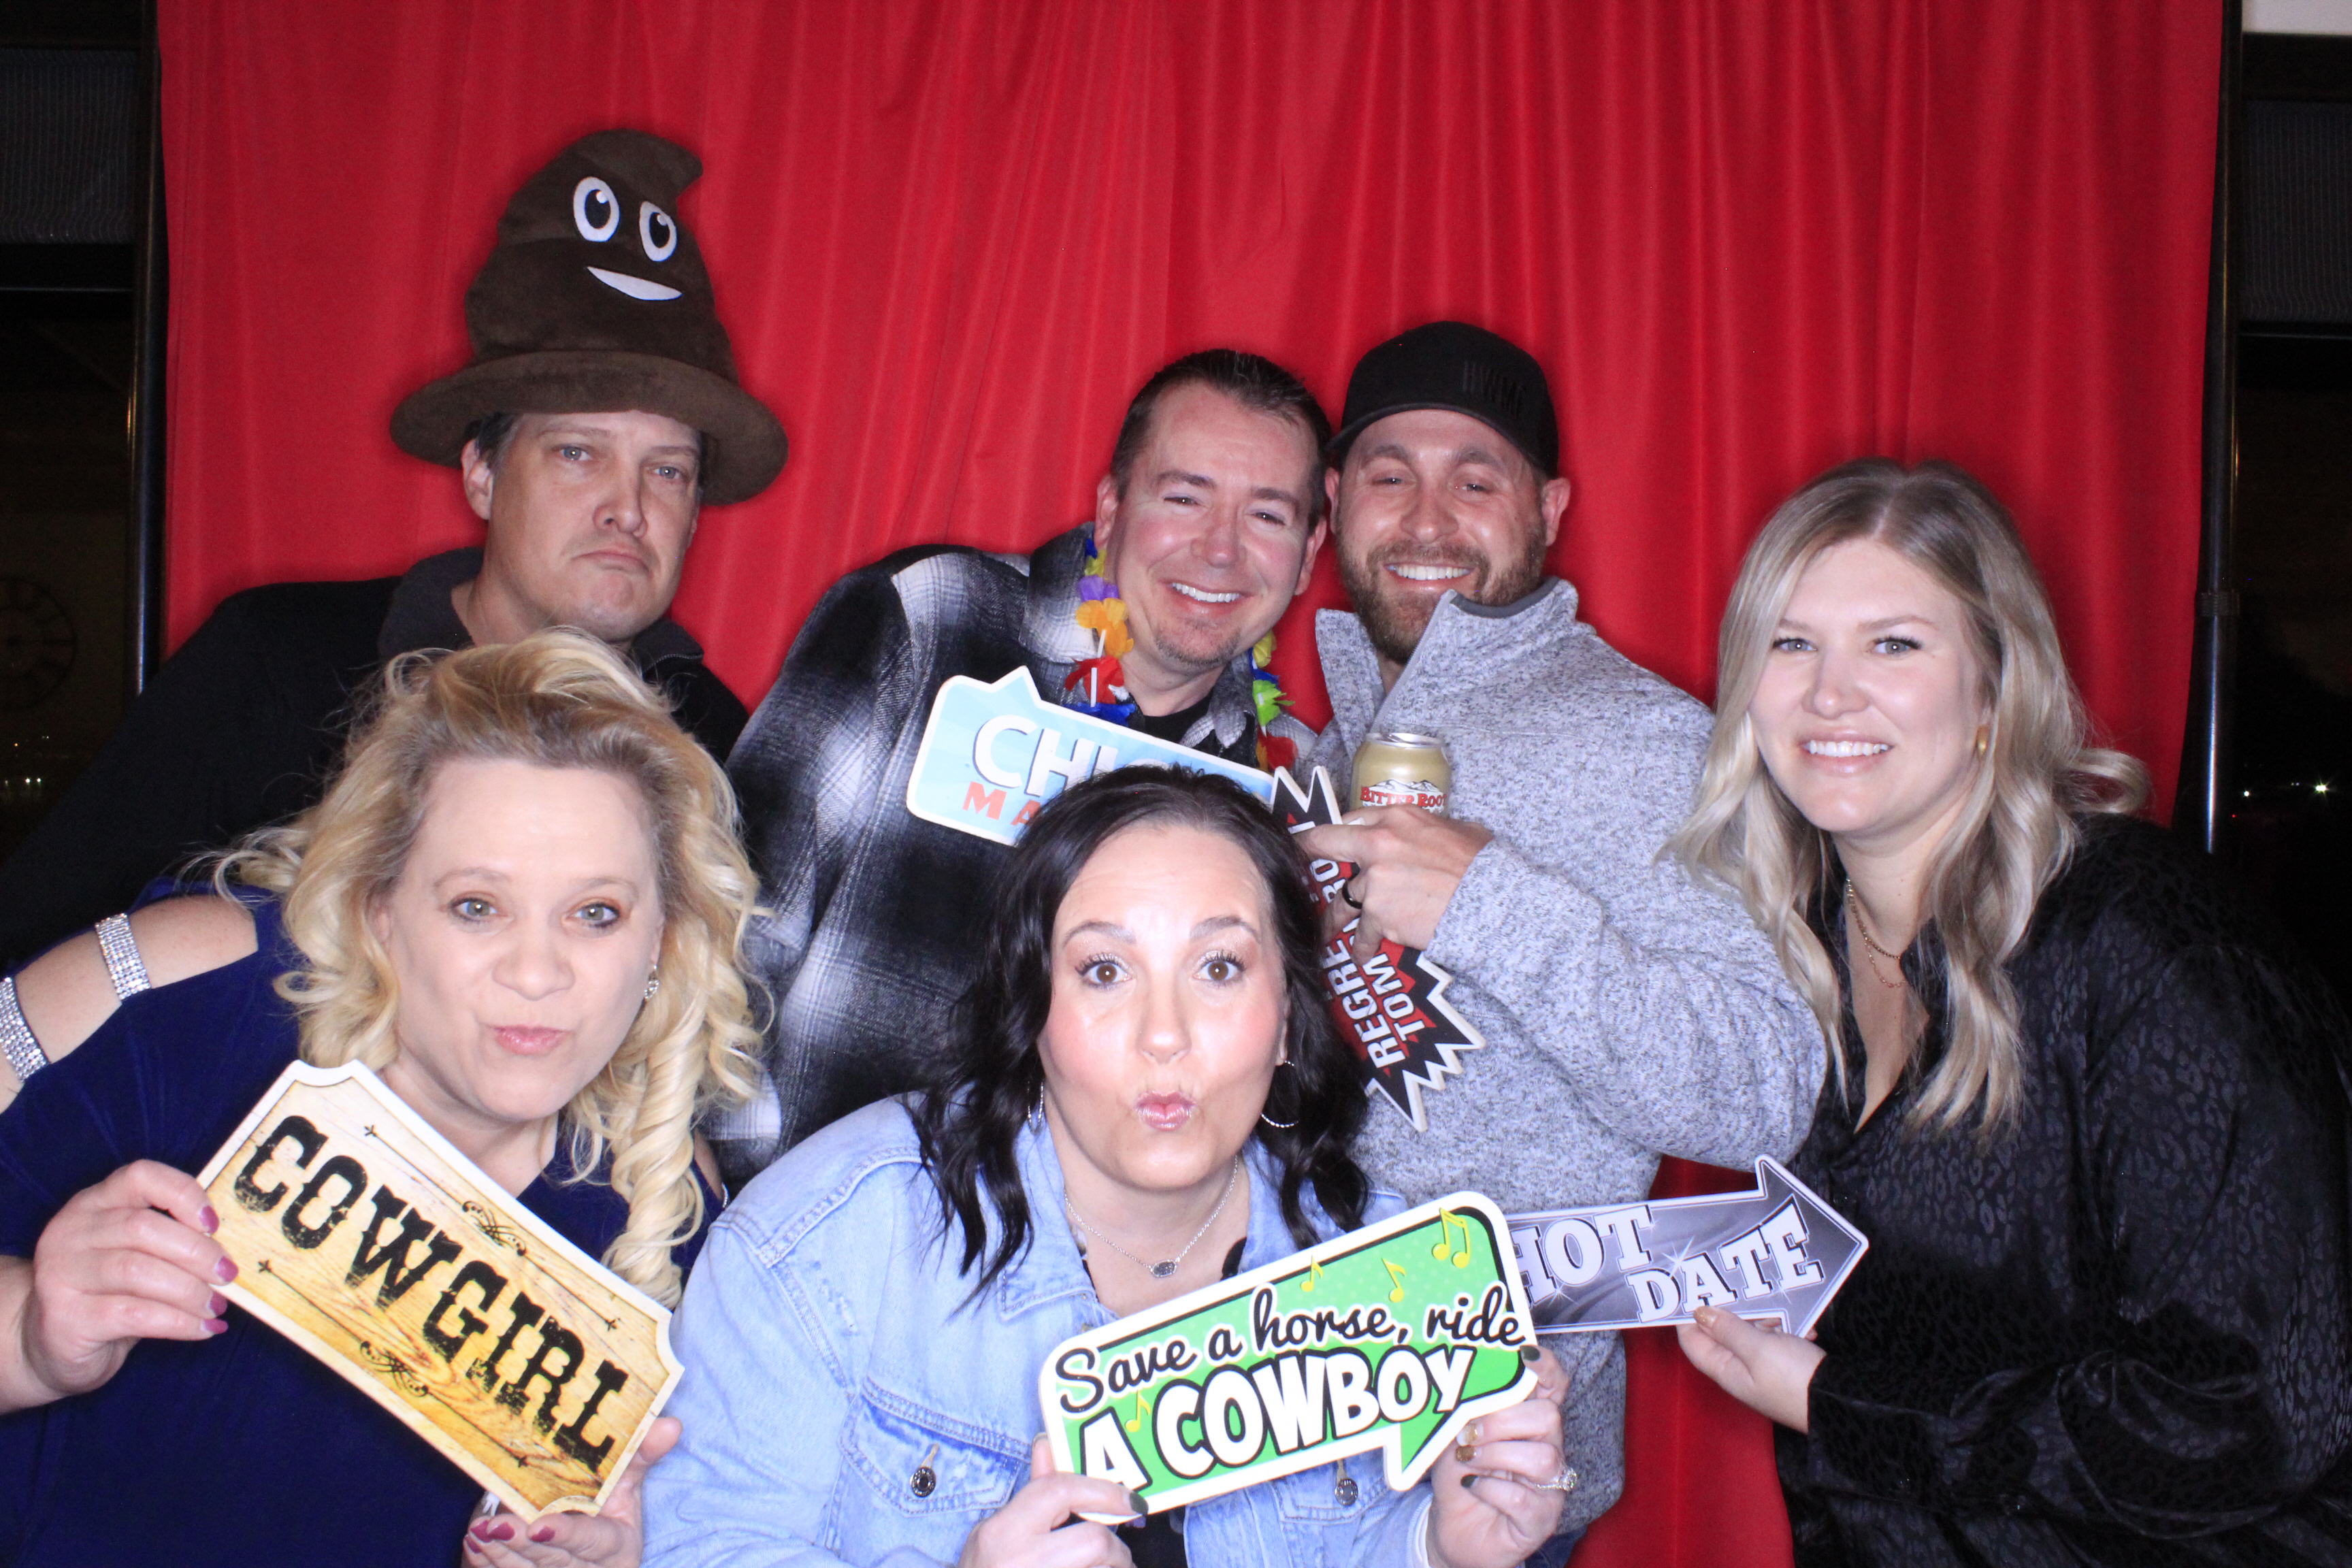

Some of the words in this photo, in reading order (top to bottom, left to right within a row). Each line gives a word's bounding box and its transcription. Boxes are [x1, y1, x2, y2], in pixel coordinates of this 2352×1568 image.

[1360, 787, 1414, 804] BITTER
[1319, 939, 1405, 1068] REGRE
[233, 1115, 629, 1475] COWGIRL
[1510, 1205, 1654, 1306] HOT
[1627, 1194, 1825, 1323] DATE
[1056, 1340, 1198, 1414] Save
[1208, 1328, 1243, 1361] a
[1253, 1288, 1408, 1352] horse,
[1427, 1285, 1526, 1346] ride
[1079, 1406, 1153, 1492] A
[1152, 1344, 1477, 1480] COWBOY
